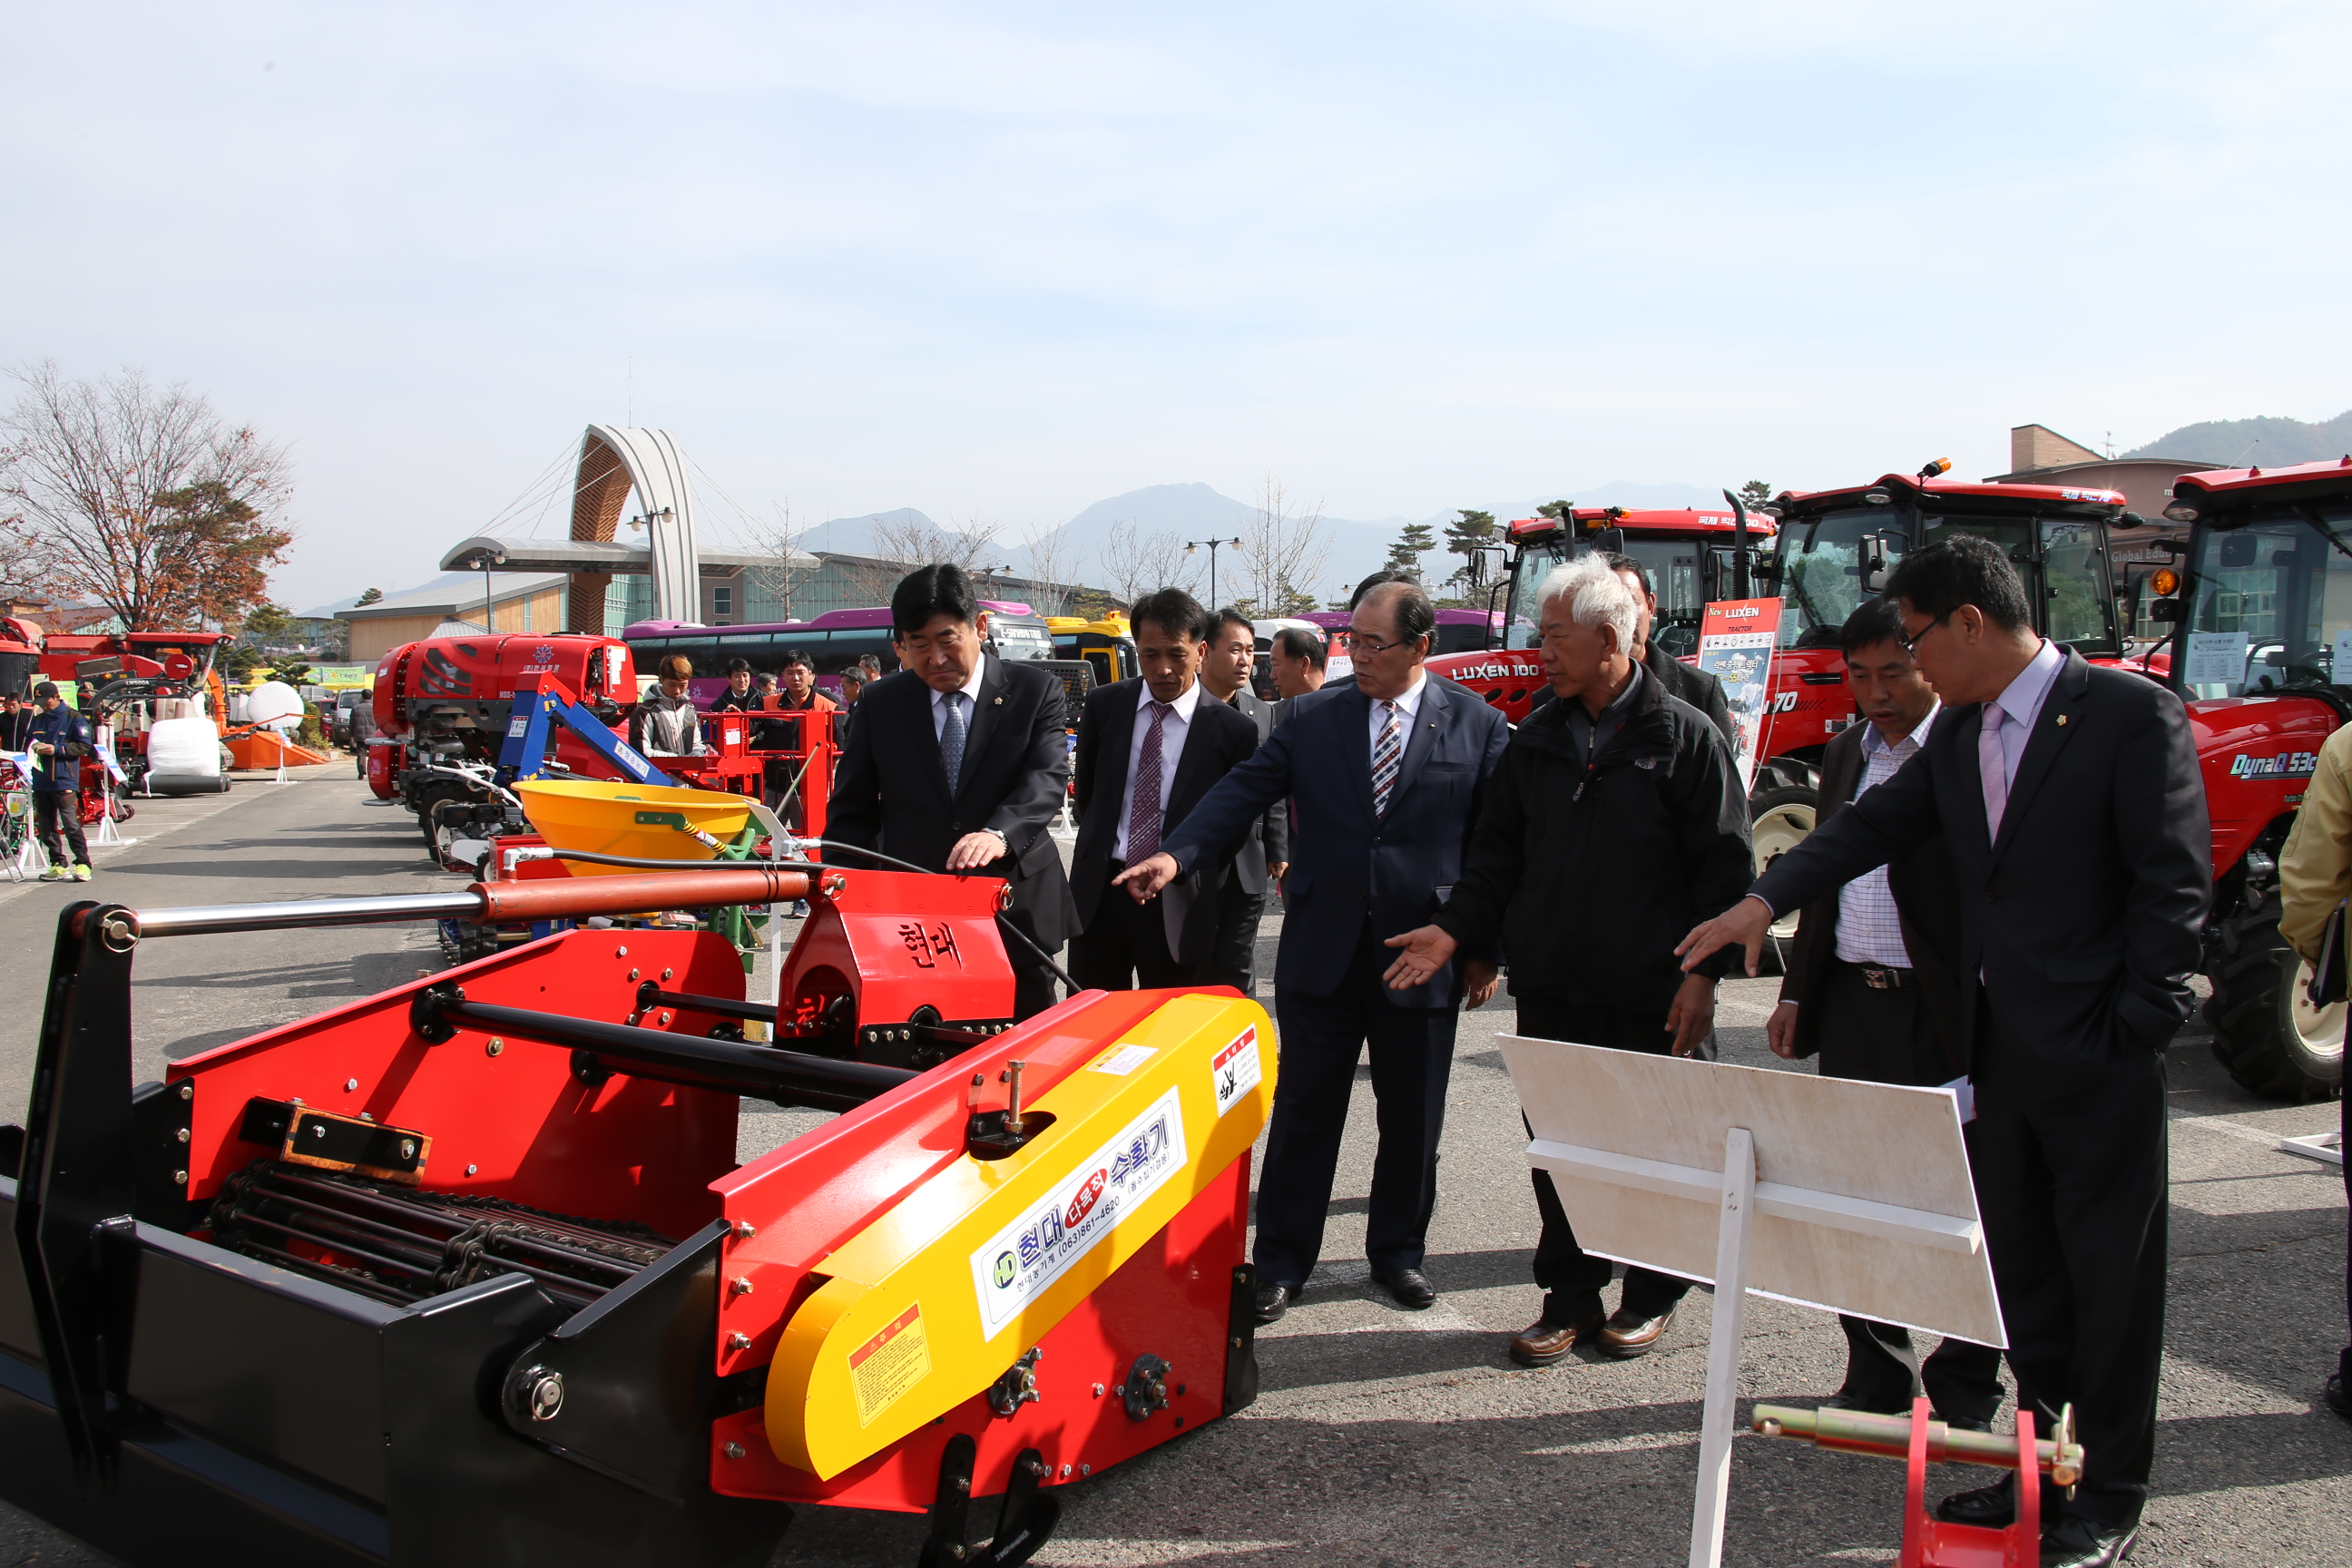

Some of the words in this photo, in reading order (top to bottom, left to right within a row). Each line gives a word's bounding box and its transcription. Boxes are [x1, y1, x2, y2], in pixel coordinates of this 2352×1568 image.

[1698, 516, 1719, 525] 국제
[2112, 549, 2142, 562] Global
[1709, 608, 1722, 616] New
[1725, 605, 1759, 621] LUXEN
[1452, 662, 1510, 681] LUXEN
[1513, 664, 1540, 676] 100
[2230, 752, 2288, 779] DynaQ
[898, 922, 962, 970] 현대
[1018, 1207, 1063, 1269] 현대
[1068, 1170, 1105, 1223] 다목적
[1111, 1116, 1169, 1185] 수확기
[1017, 1252, 1055, 1292] 현대농기계
[1058, 1195, 1120, 1257] (063)861-4620
[995, 1254, 1016, 1288] HD
